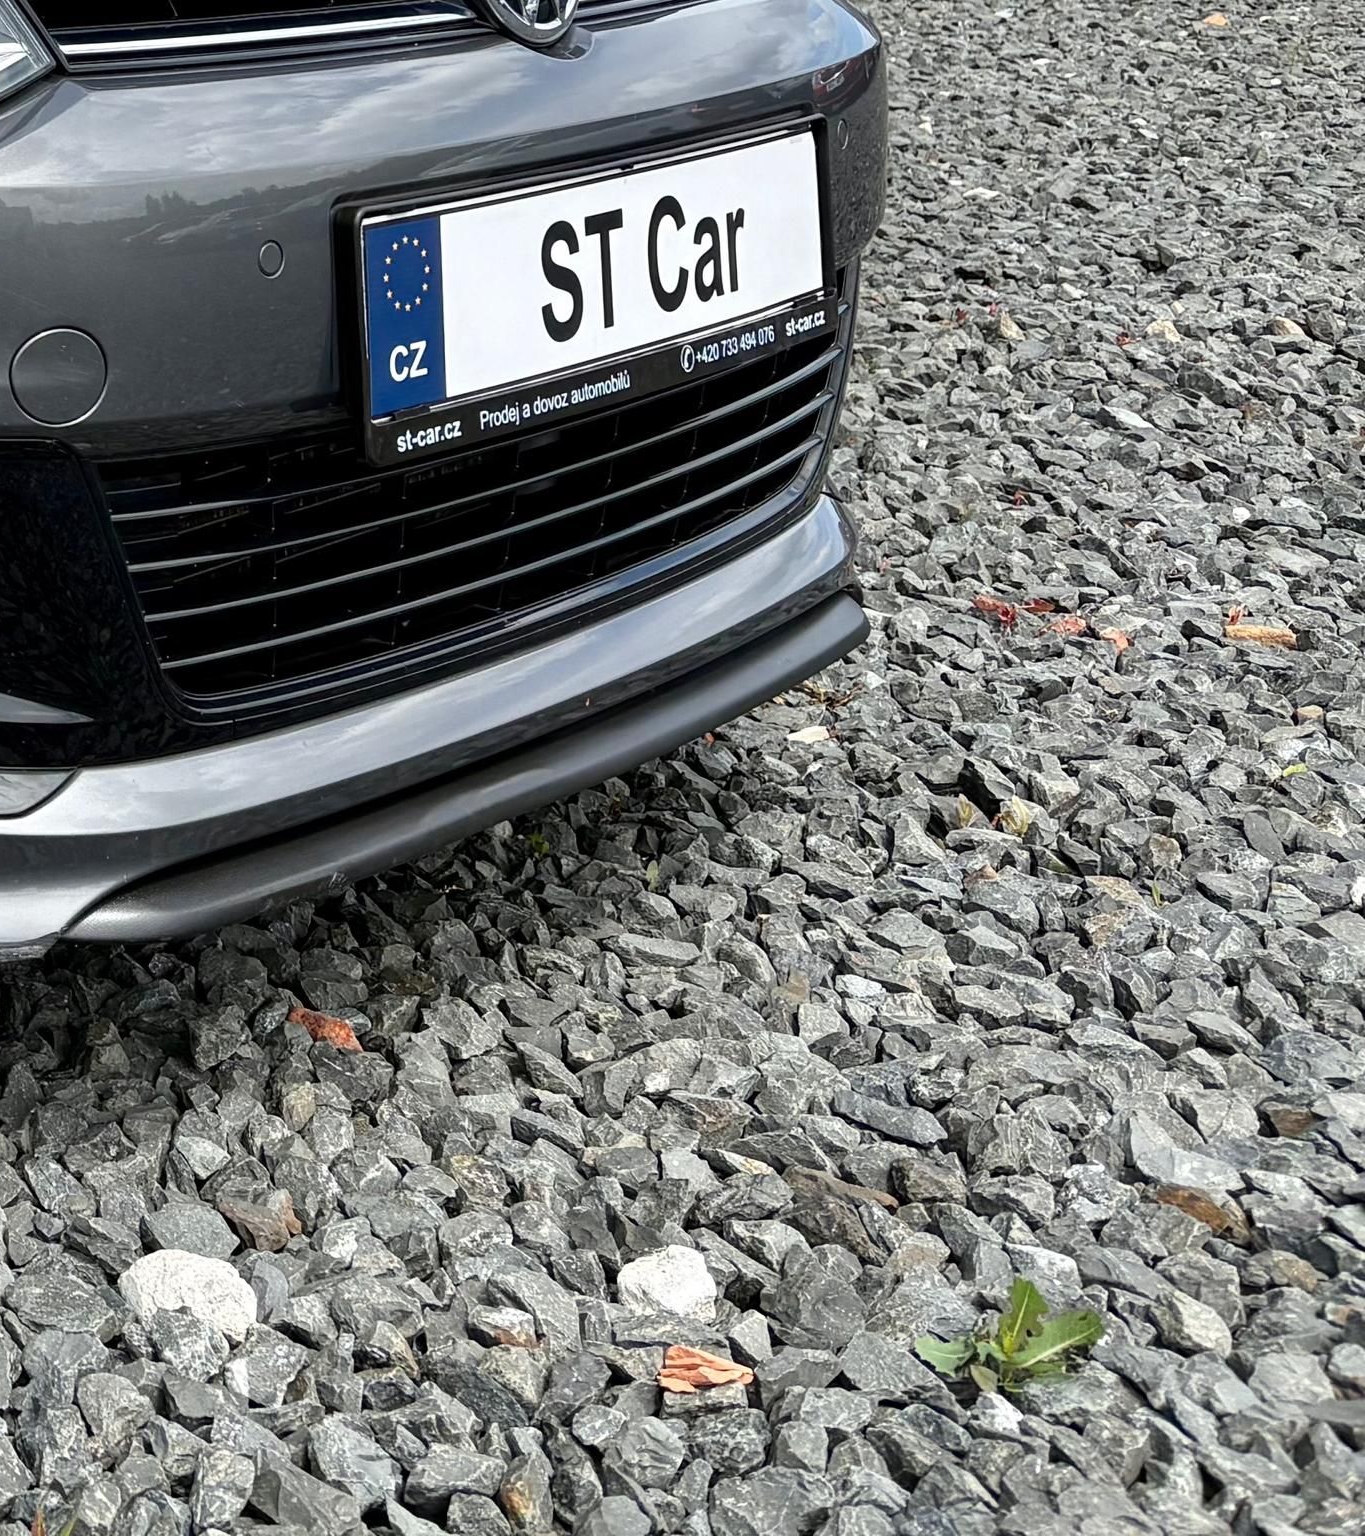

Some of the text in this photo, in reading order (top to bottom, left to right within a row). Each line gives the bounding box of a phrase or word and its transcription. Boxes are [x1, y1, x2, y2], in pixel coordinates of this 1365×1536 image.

[540, 195, 745, 343] ST Car
[389, 340, 428, 382] CZ
[396, 310, 826, 454] st-car.cz Prodej a dovoz automobilů +420 733 494 076 st-car.cz
